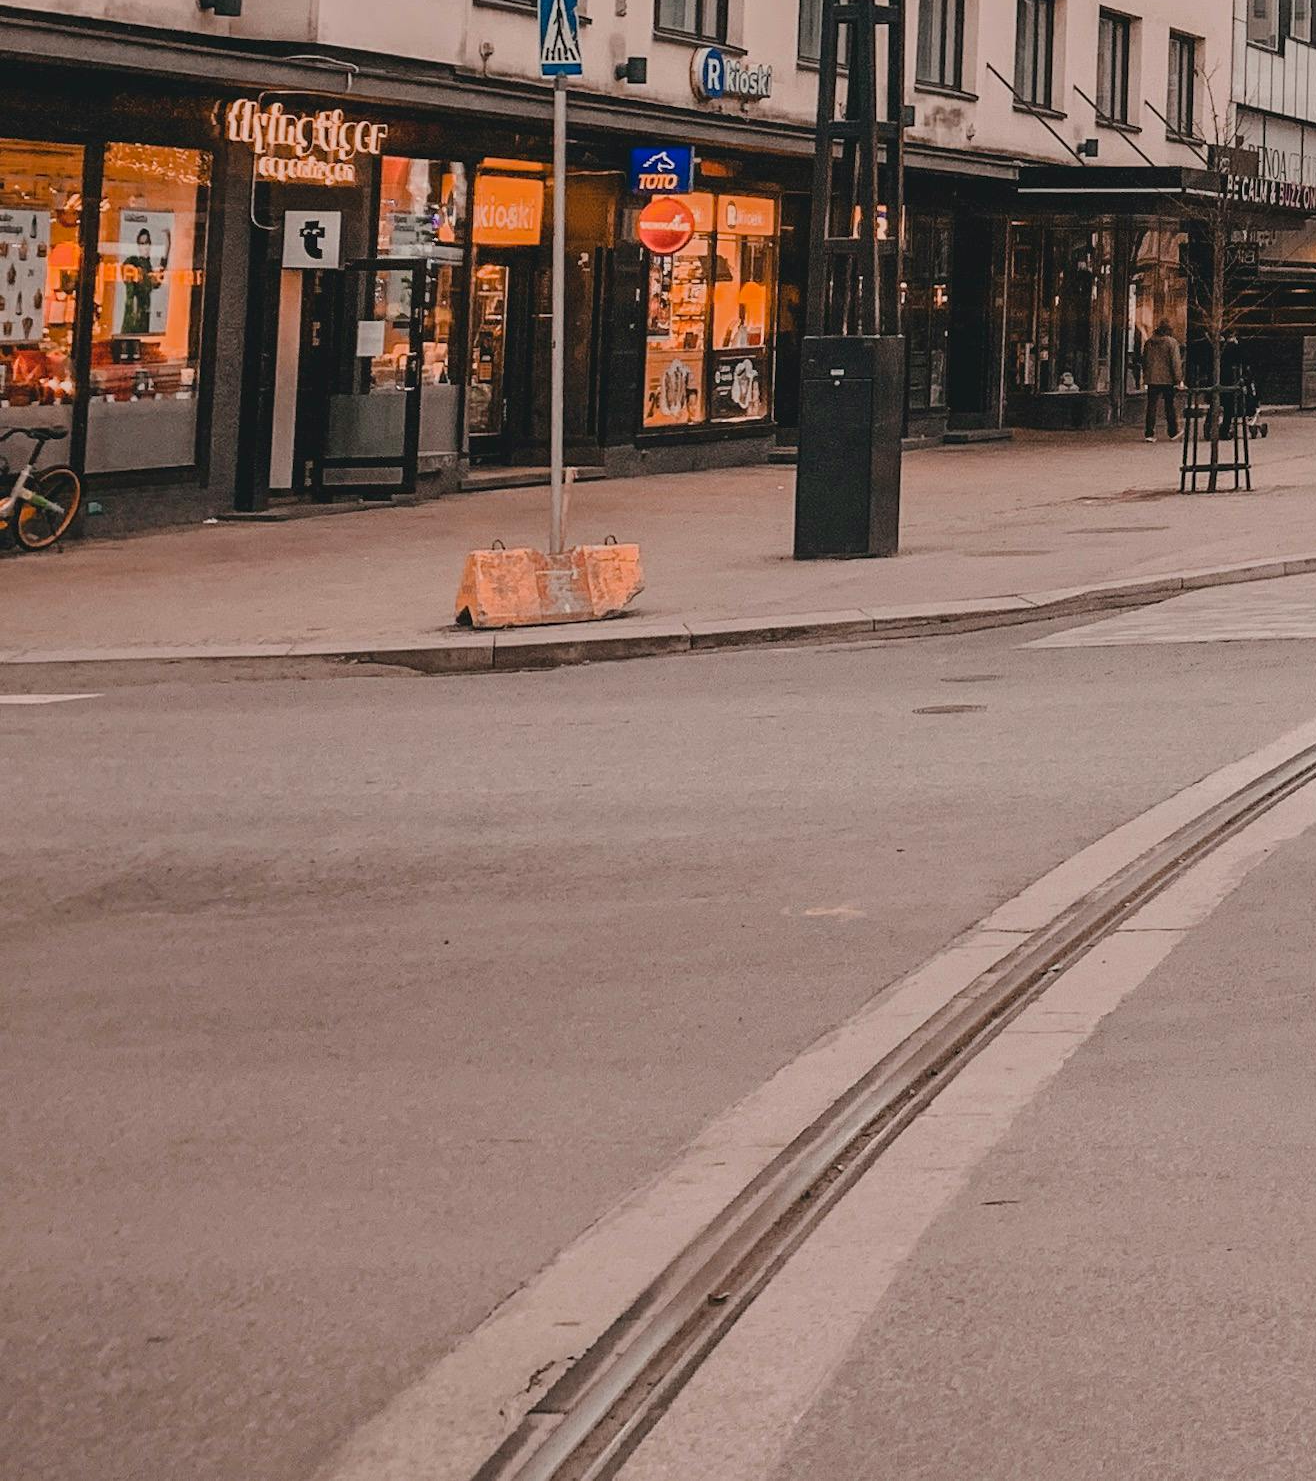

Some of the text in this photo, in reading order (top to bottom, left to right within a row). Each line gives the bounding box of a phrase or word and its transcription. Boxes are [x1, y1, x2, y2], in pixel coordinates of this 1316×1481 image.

[707, 58, 772, 96] R kioski
[638, 173, 678, 190] TOTO
[1242, 176, 1268, 203] CALM
[1279, 183, 1301, 208] BUZZ
